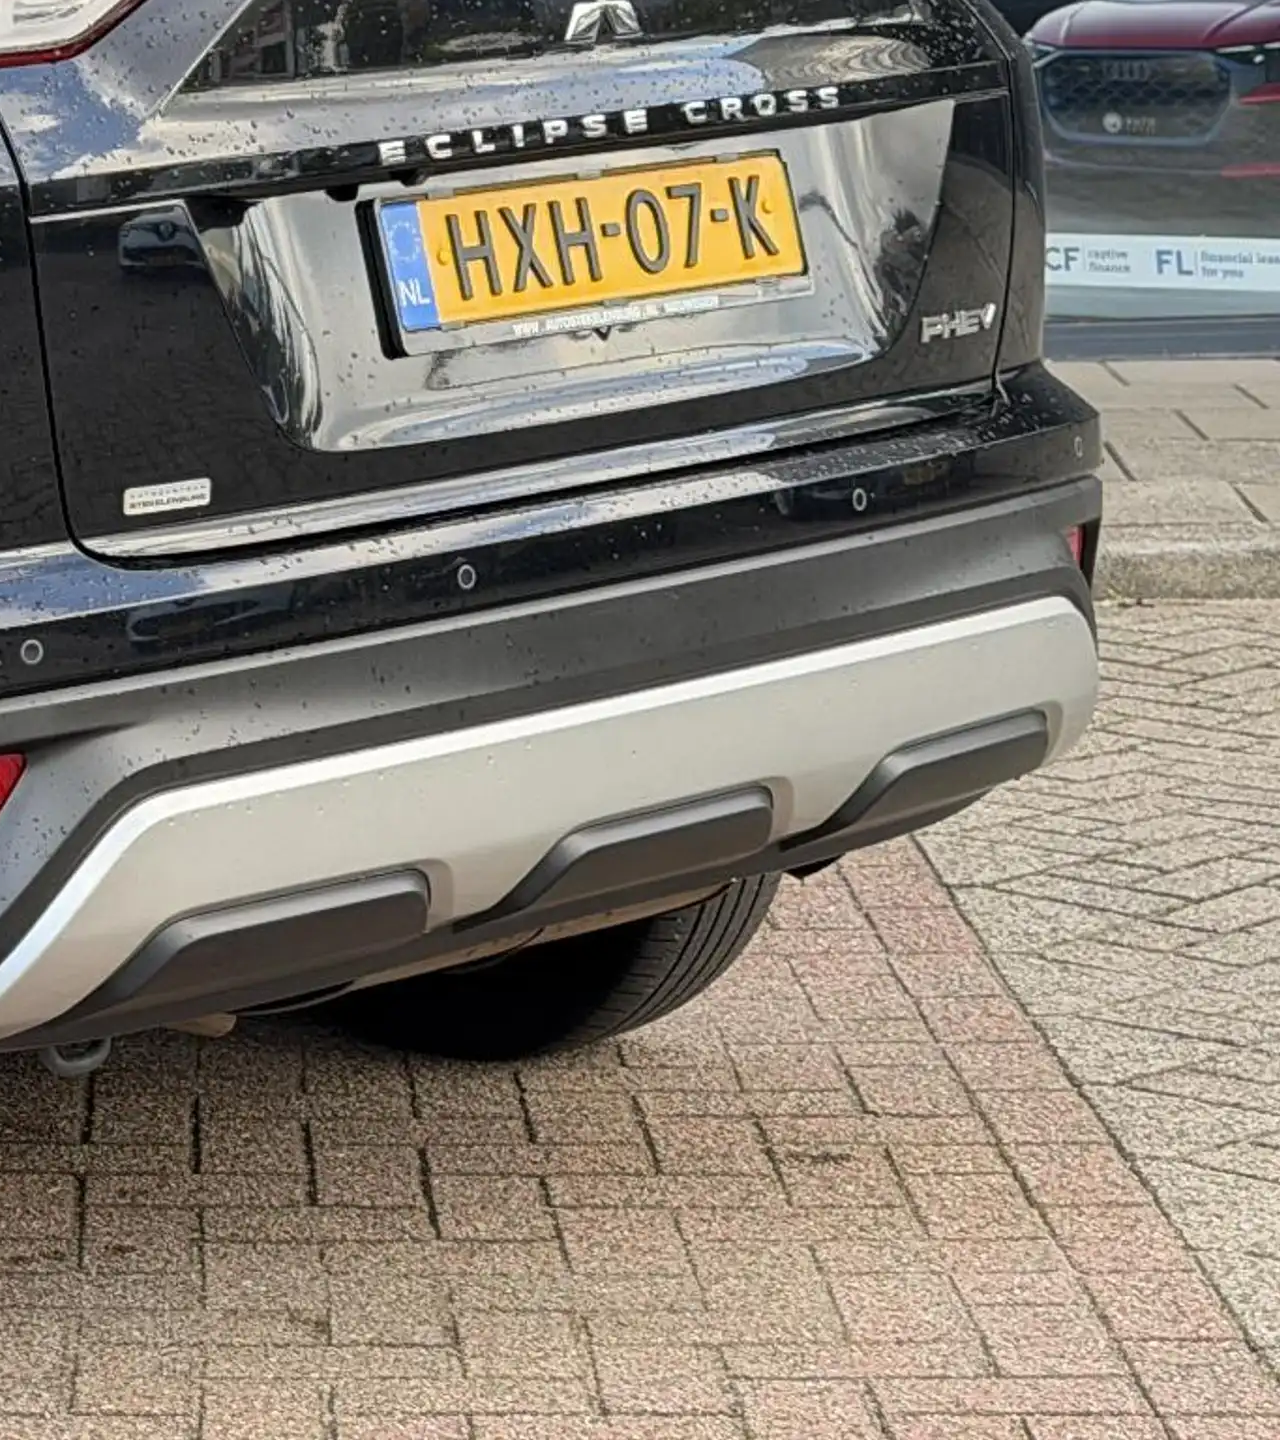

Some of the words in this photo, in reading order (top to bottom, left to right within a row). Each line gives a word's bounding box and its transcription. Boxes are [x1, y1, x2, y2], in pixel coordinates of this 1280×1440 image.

[378, 108, 648, 165] ECLIPSE
[681, 85, 840, 126] CROSS
[445, 173, 780, 300] HXH-07-K
[1156, 249, 1194, 276] FL
[398, 278, 431, 307] NL
[920, 302, 997, 343] PHEV
